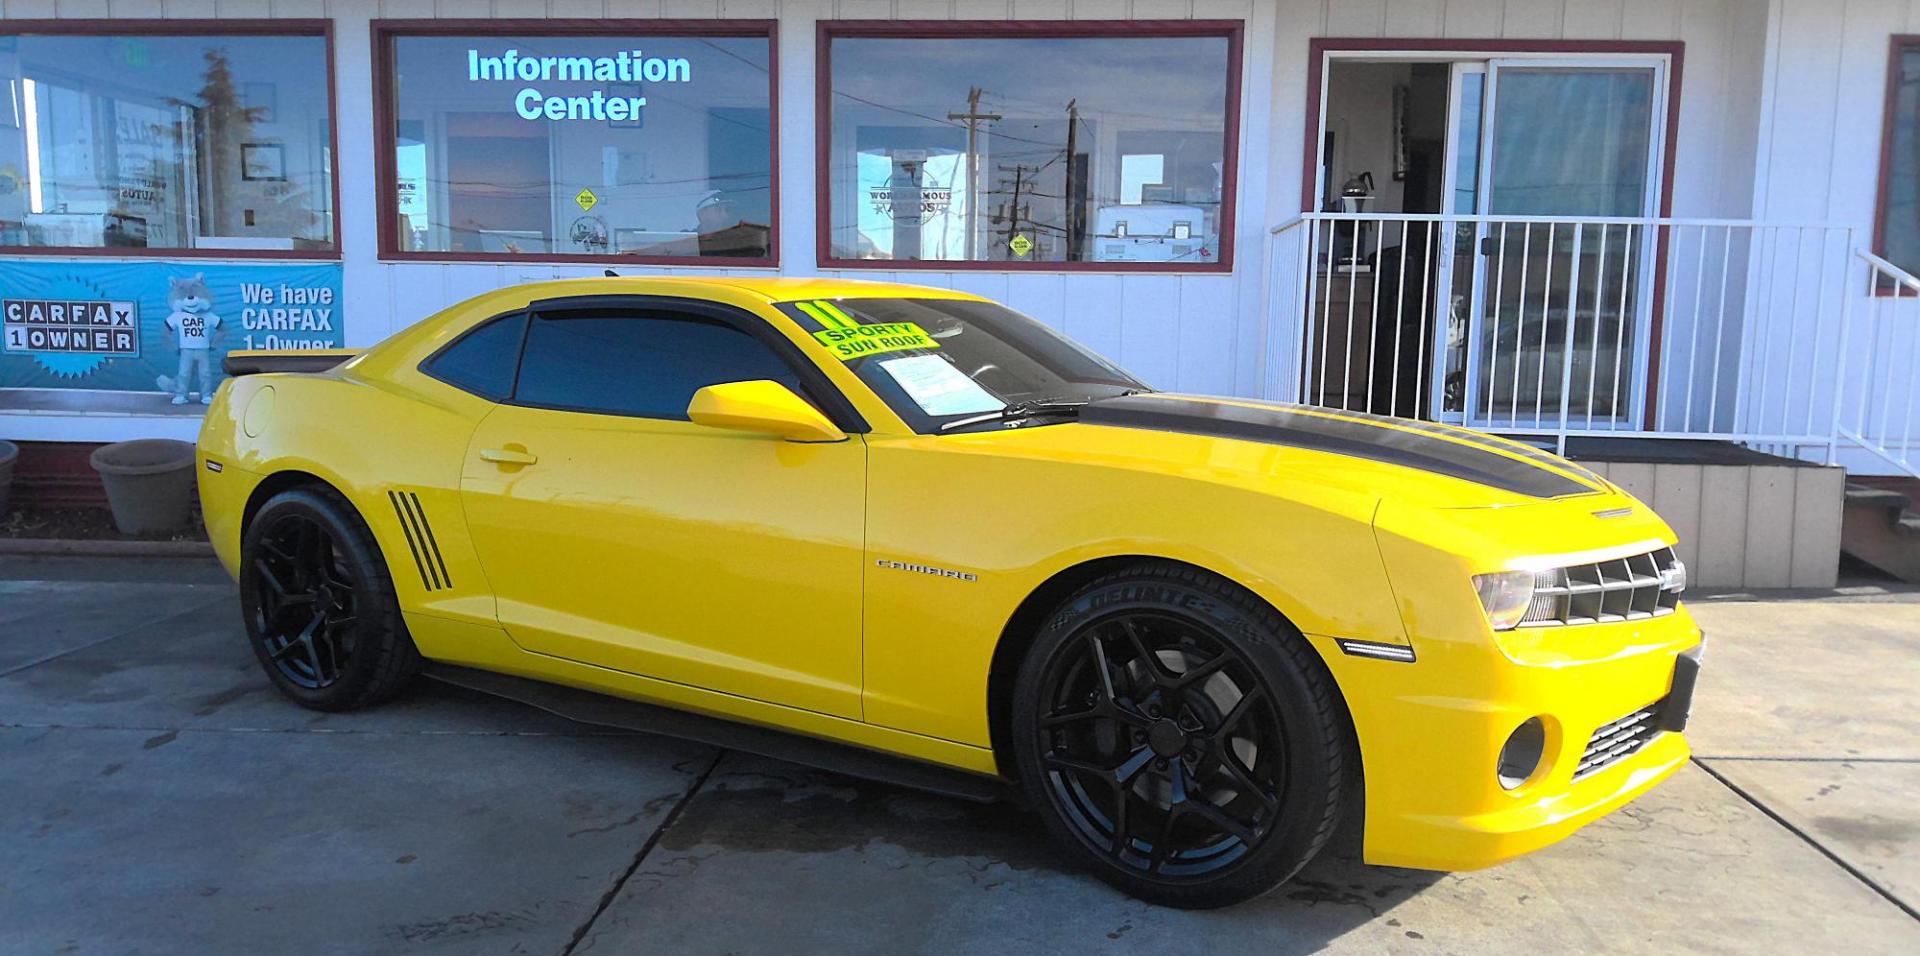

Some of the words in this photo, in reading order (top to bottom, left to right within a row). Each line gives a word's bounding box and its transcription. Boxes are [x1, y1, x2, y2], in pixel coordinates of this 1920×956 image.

[468, 50, 690, 82] Information
[514, 88, 646, 120] Center
[240, 284, 273, 304] We
[281, 284, 332, 304] have
[5, 302, 130, 326] CARFAX
[182, 317, 205, 328] CAR
[242, 309, 331, 331] CARFAX
[11, 331, 21, 347] 1
[30, 331, 131, 349] OWNER
[184, 328, 204, 338] FOX
[243, 335, 333, 350] 1-Owner
[825, 323, 912, 342] SPORTY
[837, 339, 878, 355] SUN
[883, 335, 927, 348] ROOF
[876, 559, 979, 582] CAMARO
